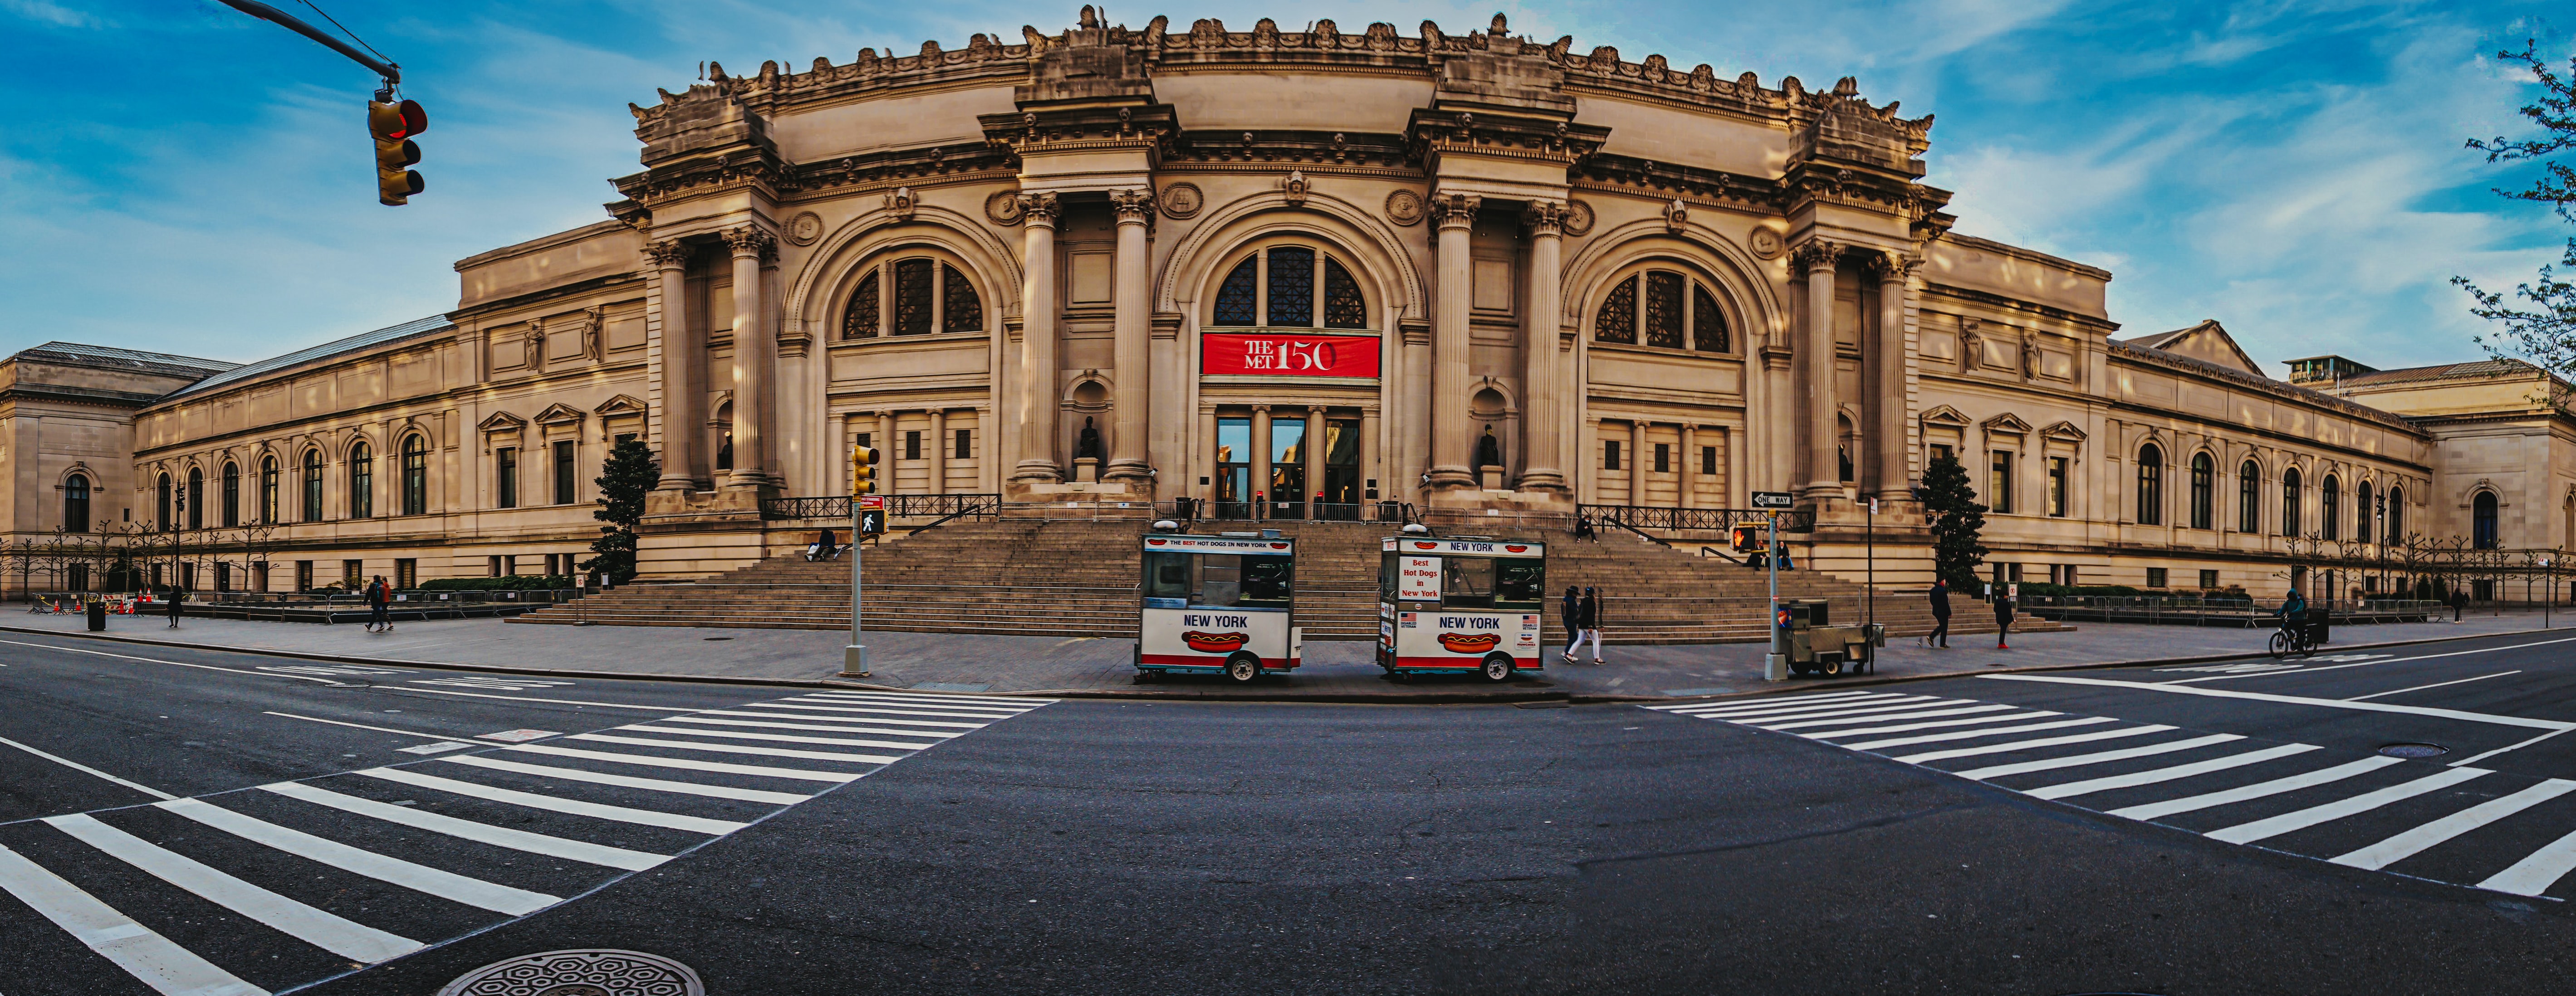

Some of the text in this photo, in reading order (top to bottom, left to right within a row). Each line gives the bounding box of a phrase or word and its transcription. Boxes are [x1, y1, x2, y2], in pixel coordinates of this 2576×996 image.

[1244, 341, 1273, 354] THE
[1244, 355, 1274, 369] MET
[1274, 341, 1337, 371] 150
[1450, 542, 1493, 552] NEW YORK
[1419, 570, 1438, 578] Dogs
[1184, 615, 1248, 628] NEW YORK
[1440, 617, 1500, 629] NEW YORK
